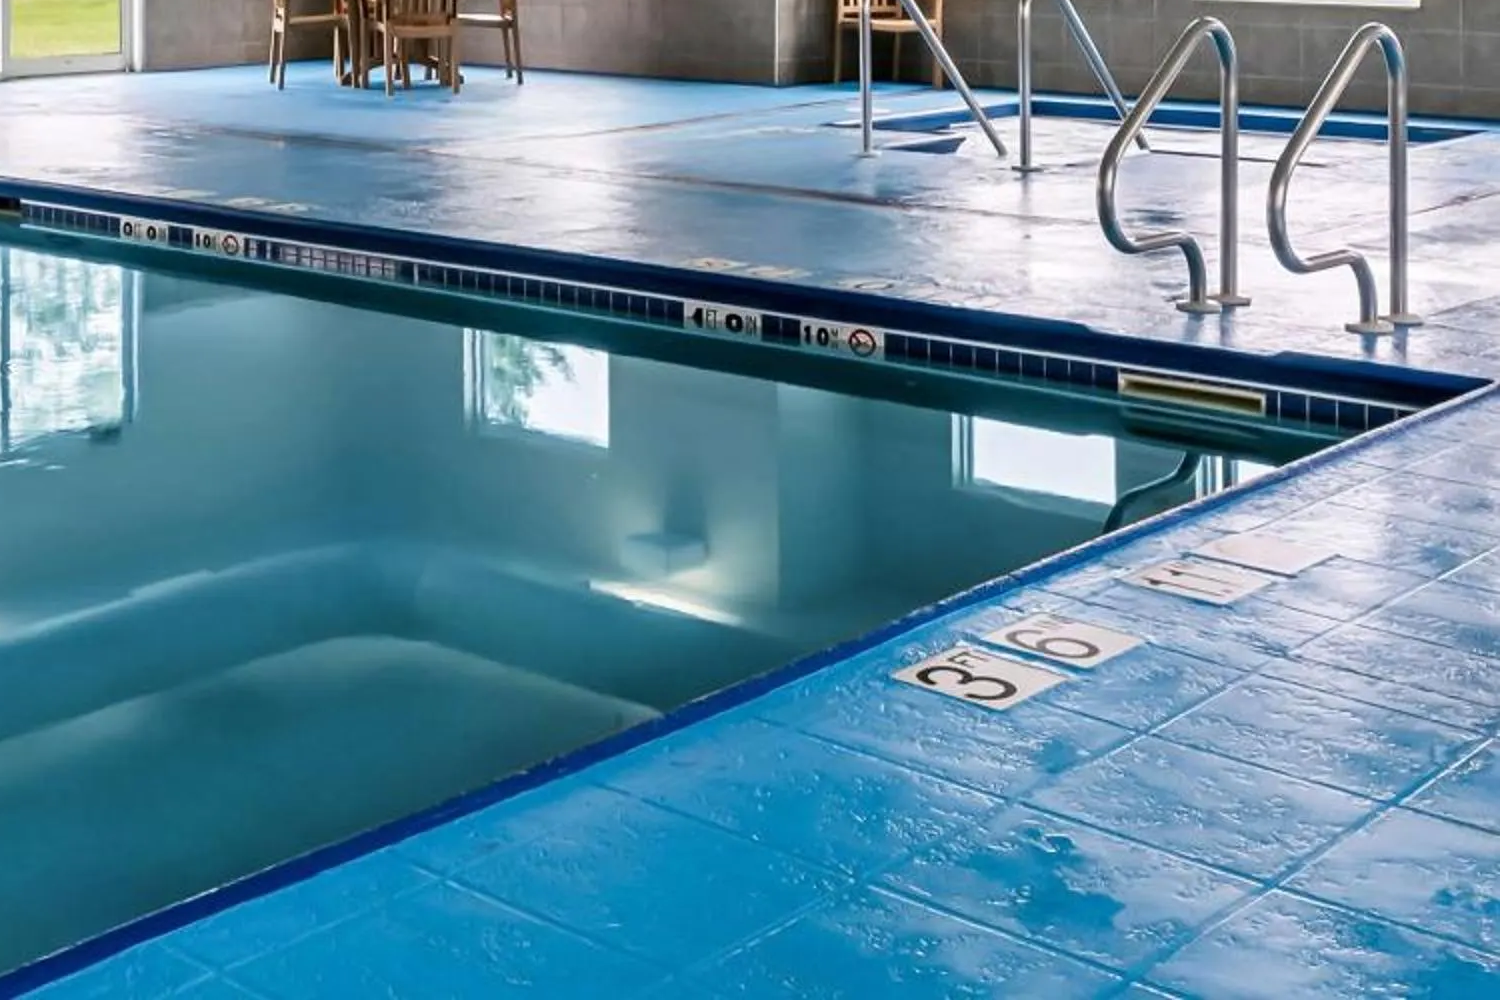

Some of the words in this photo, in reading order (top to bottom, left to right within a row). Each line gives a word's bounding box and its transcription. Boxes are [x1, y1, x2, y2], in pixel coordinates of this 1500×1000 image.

[1005, 629, 1100, 658] 6
[947, 651, 989, 668] FT
[916, 666, 1017, 699] 3
